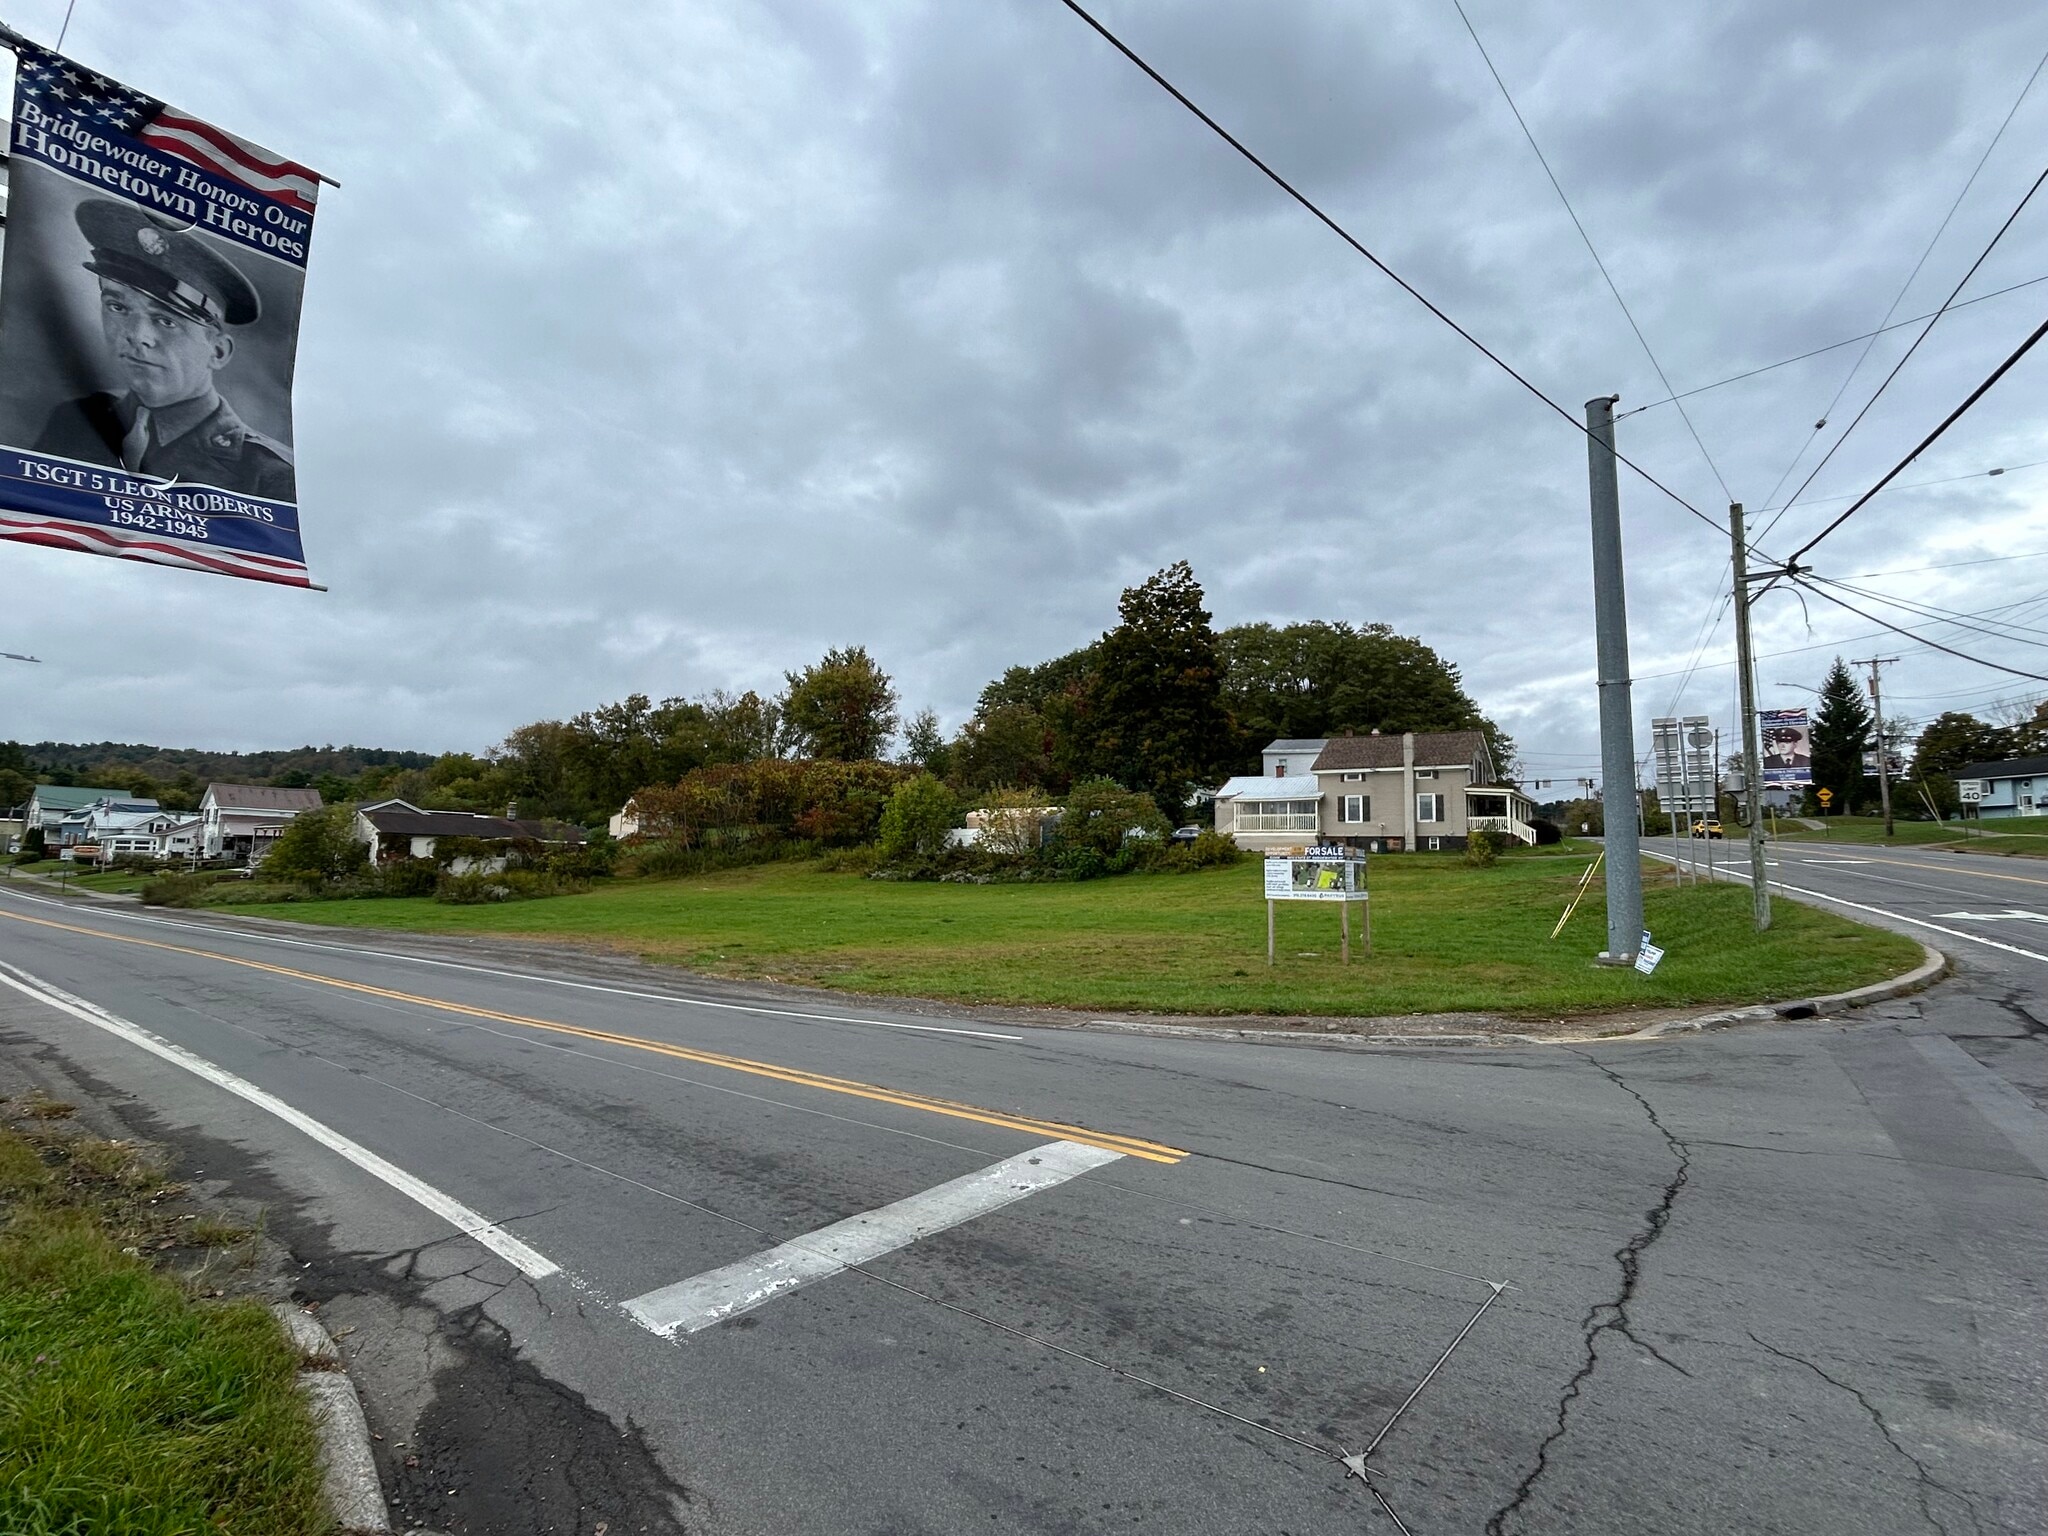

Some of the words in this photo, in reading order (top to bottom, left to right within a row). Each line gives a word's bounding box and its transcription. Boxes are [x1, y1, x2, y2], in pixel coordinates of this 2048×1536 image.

[19, 100, 172, 178] Bridgewater
[176, 166, 260, 216] Honors
[264, 205, 307, 234] Our
[15, 122, 196, 217] Hometown
[201, 199, 304, 259] Heroes
[18, 459, 86, 487] TSGT
[91, 475, 103, 490] 5
[108, 477, 172, 503] LEON
[176, 493, 274, 522] ROBERTS
[104, 497, 135, 511] US
[140, 503, 209, 527] ARMY
[109, 510, 208, 539] 1942-1945
[1962, 792, 1980, 800] 40
[1305, 847, 1321, 856] FOR
[1321, 847, 1344, 856] SALE
